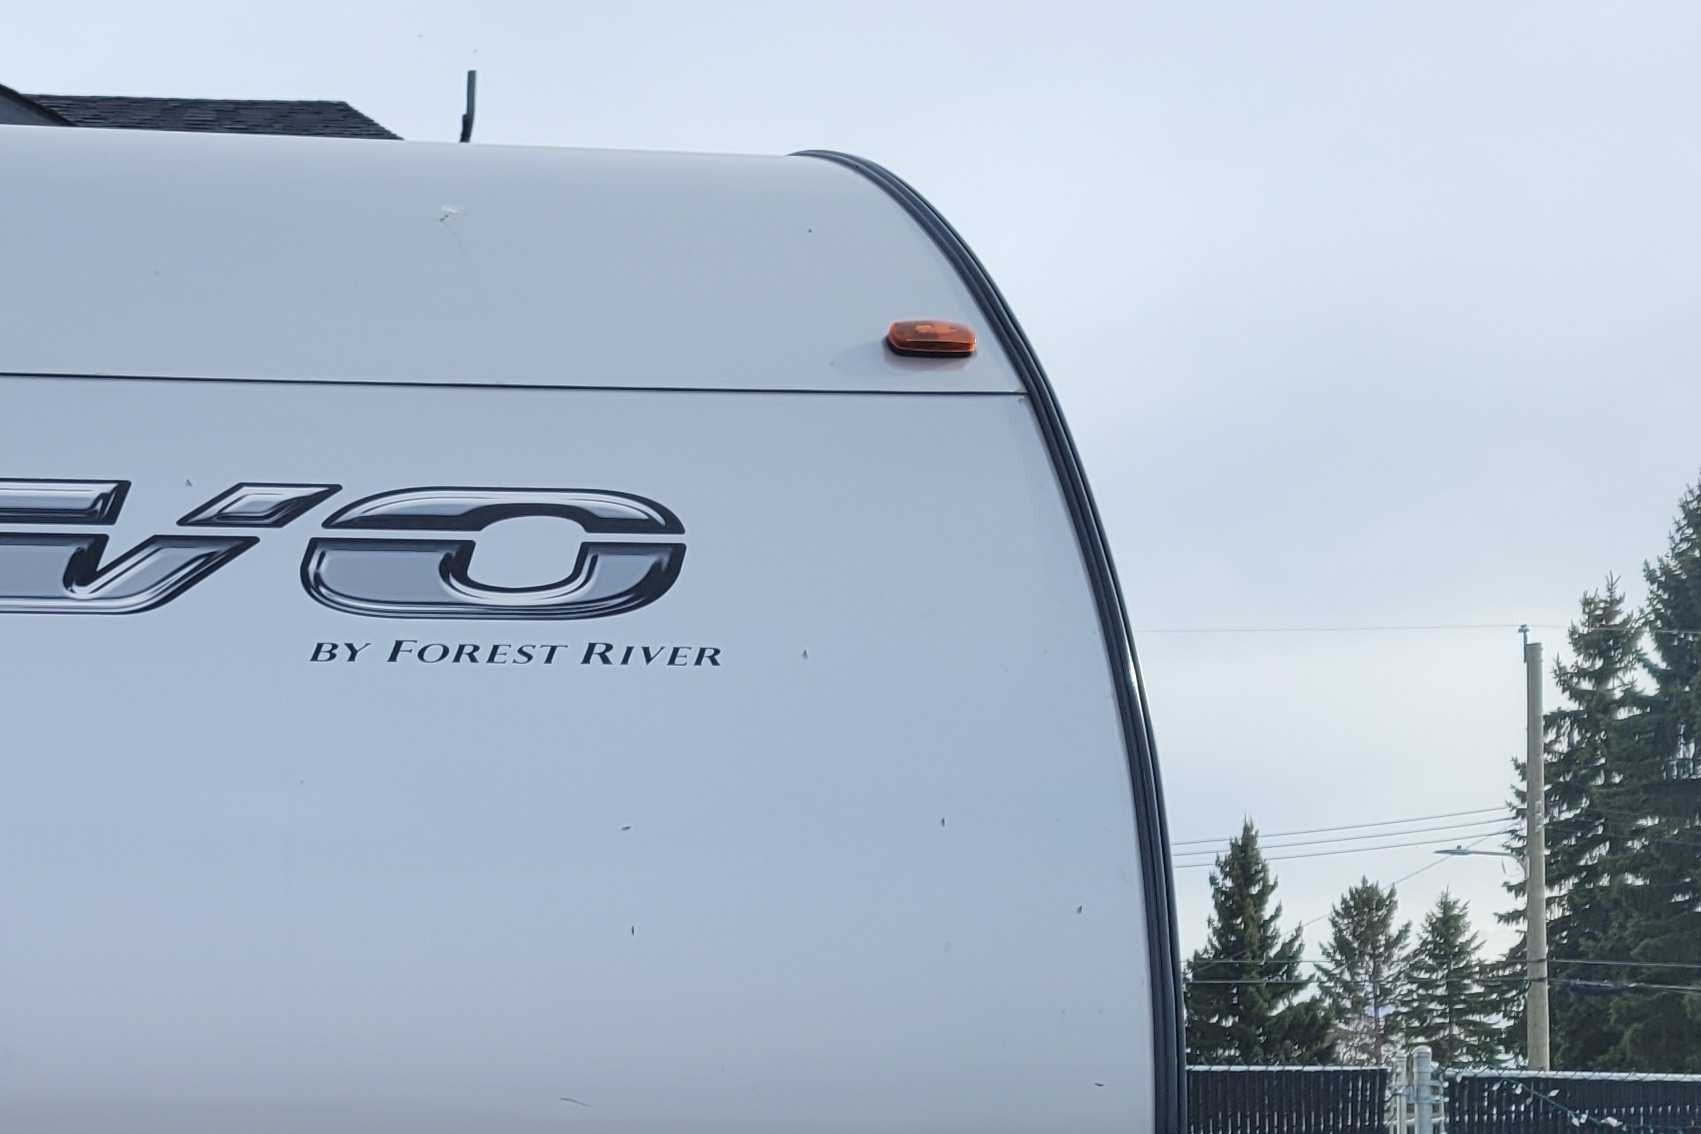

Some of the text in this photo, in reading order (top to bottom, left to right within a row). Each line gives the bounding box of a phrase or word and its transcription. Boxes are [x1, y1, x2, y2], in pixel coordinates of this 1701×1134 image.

[309, 639, 722, 667] BY FOREST RIVER
